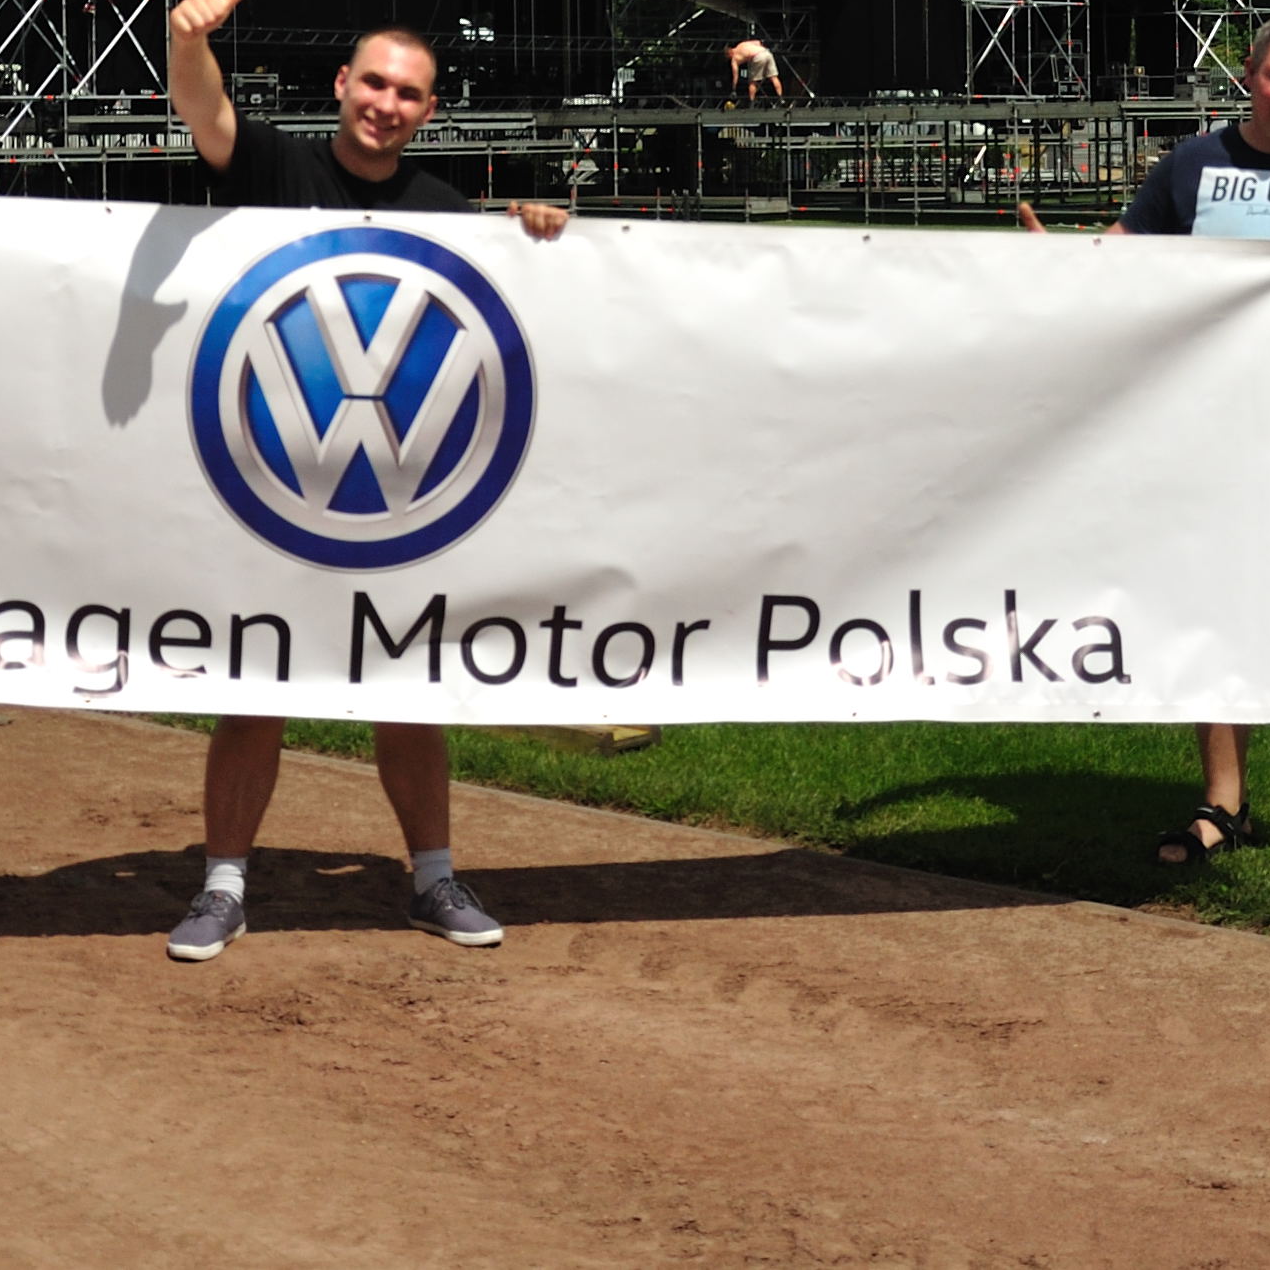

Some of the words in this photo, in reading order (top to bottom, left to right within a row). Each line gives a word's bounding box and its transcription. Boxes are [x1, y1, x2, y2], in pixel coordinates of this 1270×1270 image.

[1210, 176, 1257, 202] BIG
[348, 591, 711, 689] Motor
[756, 589, 1133, 688] Polska
